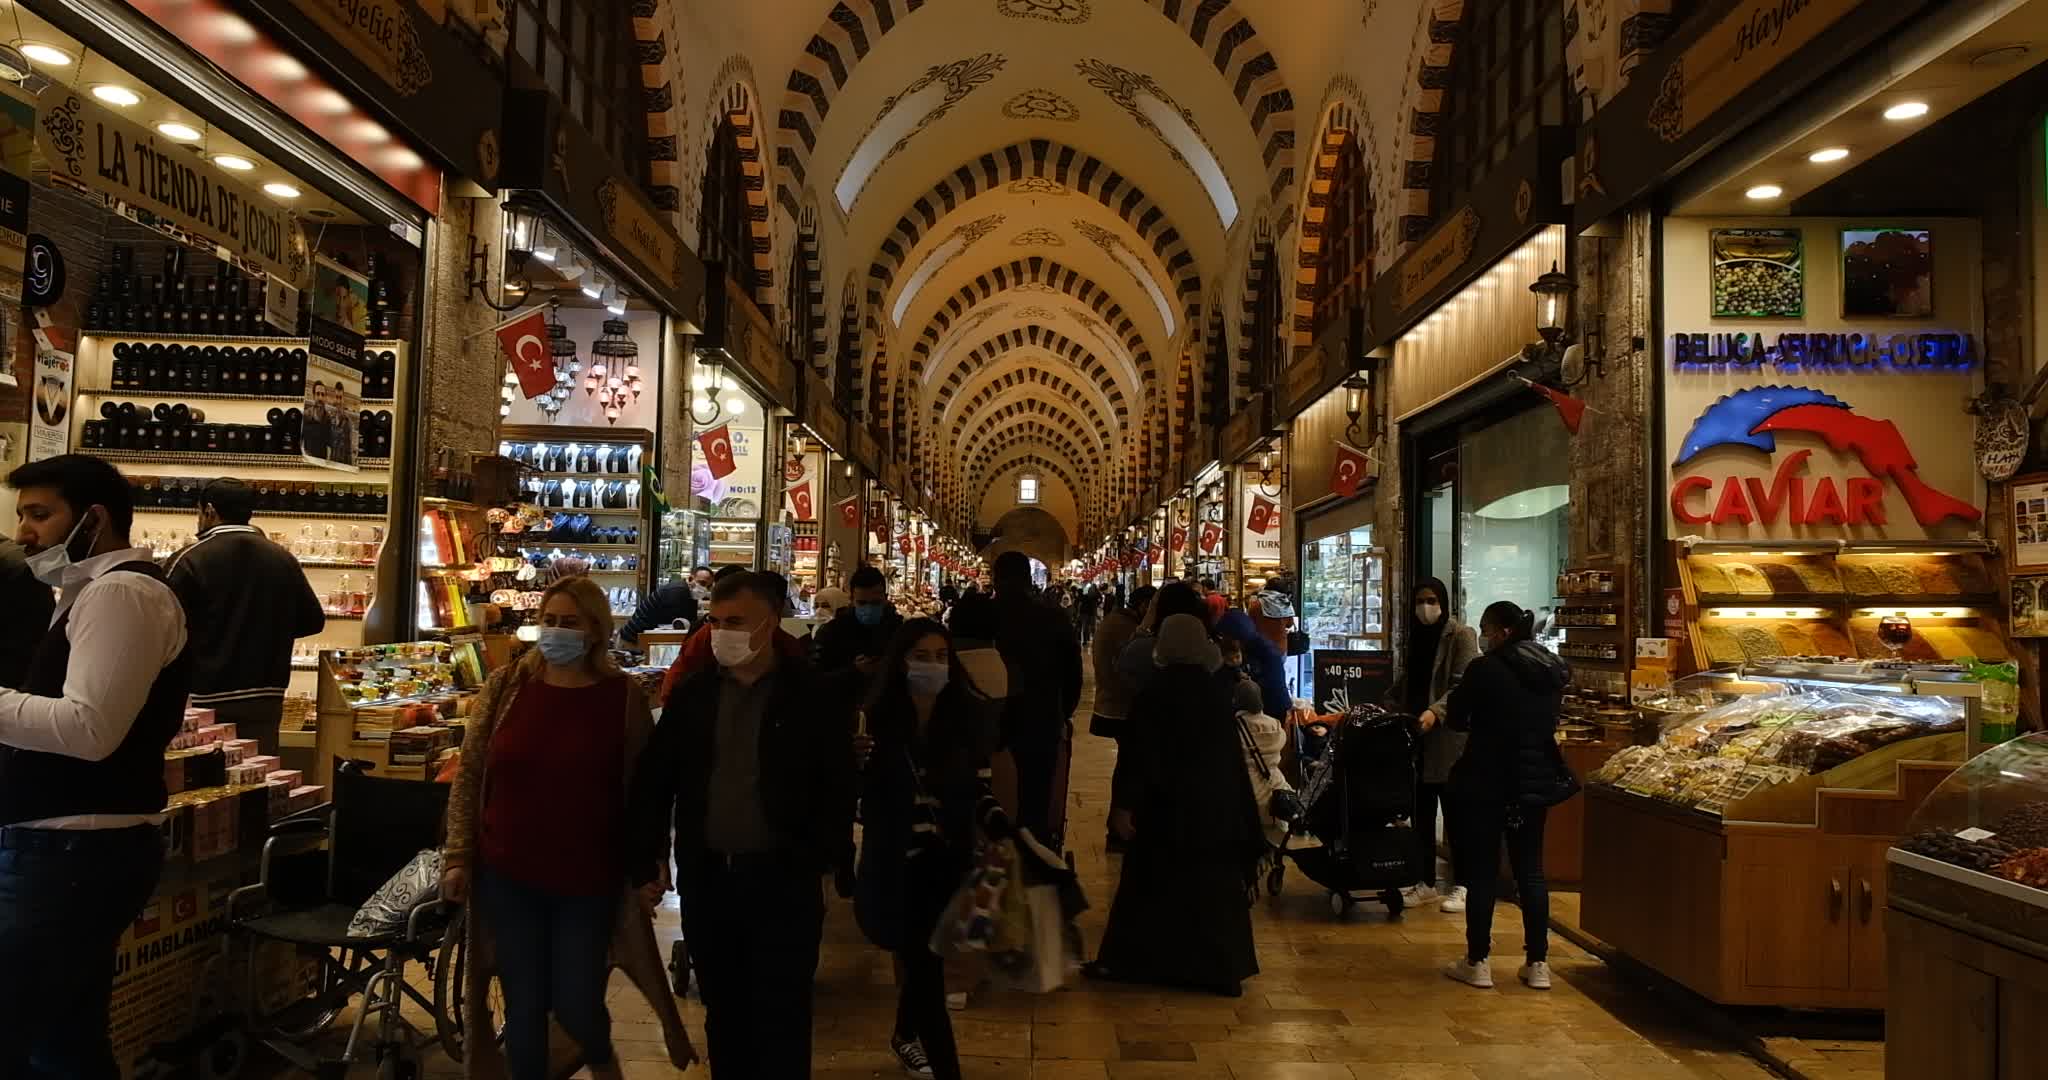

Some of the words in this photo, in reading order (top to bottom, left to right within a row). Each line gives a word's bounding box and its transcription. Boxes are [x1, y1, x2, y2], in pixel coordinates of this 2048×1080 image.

[97, 122, 129, 187] LA
[216, 185, 239, 240] DE
[336, 343, 358, 360] SELFIE
[1670, 449, 1888, 525] CAVIAR
